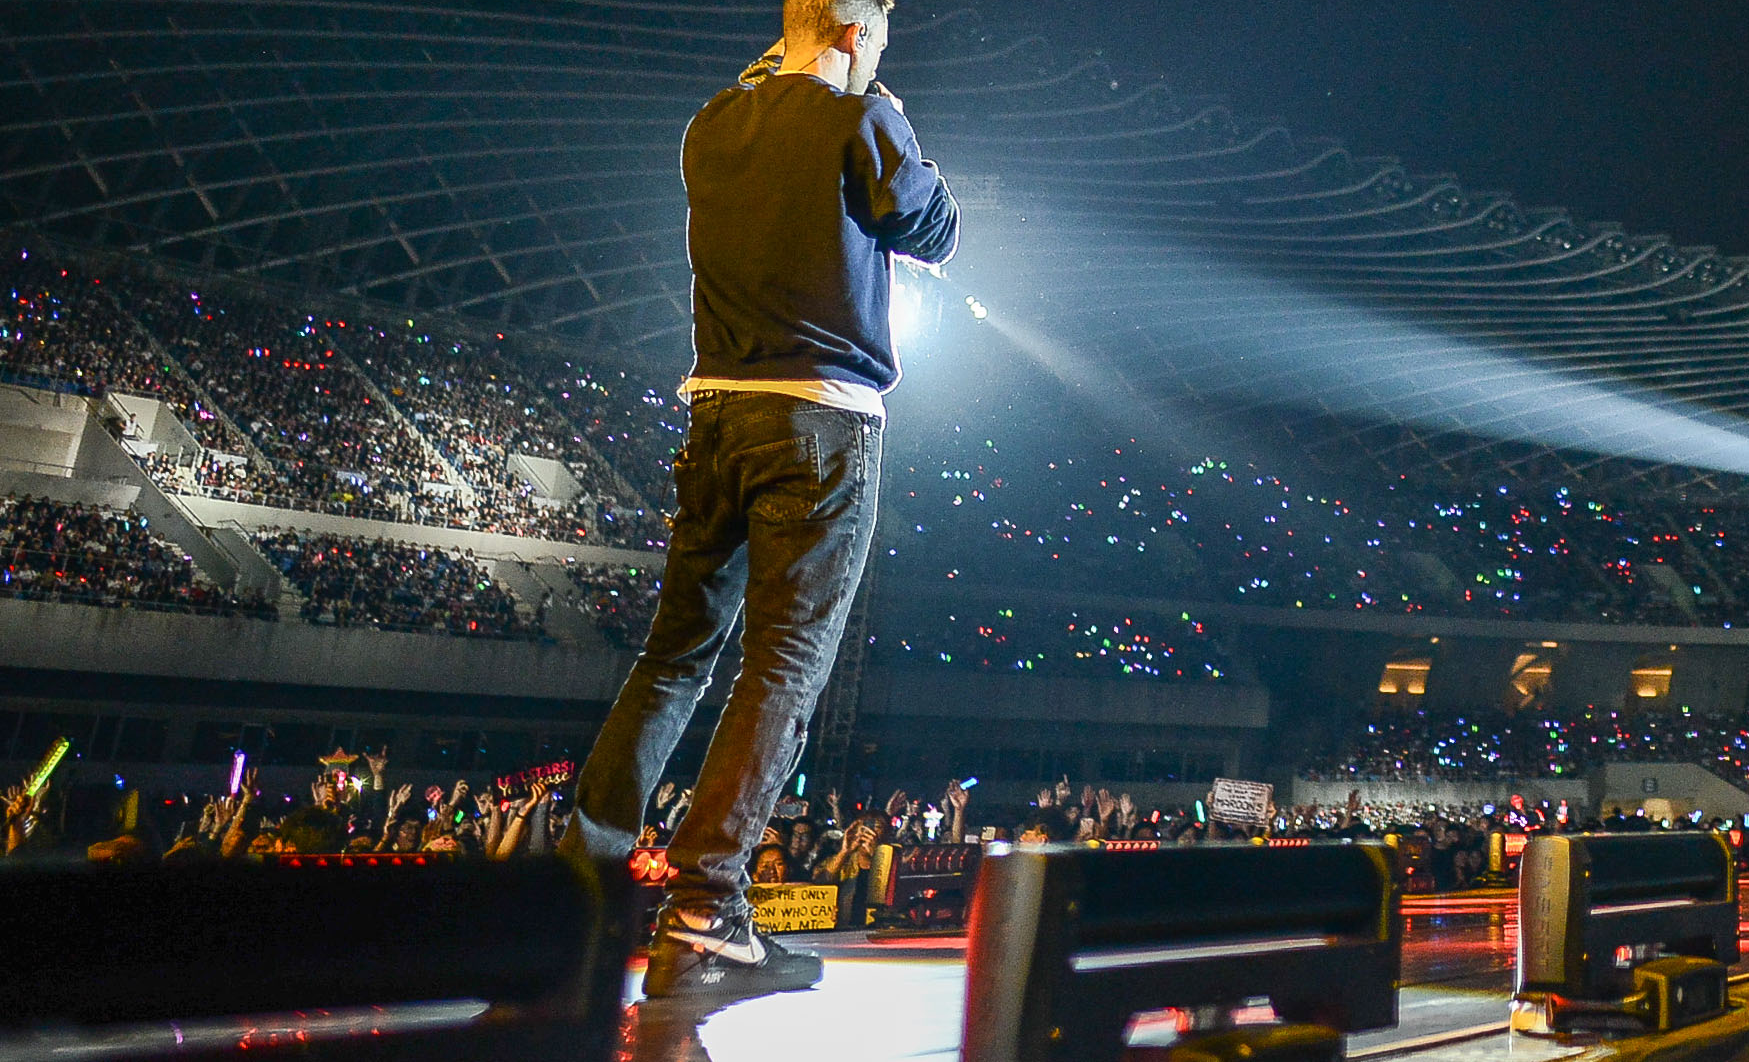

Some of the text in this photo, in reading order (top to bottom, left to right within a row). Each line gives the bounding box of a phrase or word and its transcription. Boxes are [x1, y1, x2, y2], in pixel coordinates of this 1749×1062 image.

[776, 889, 796, 900] THE
[801, 889, 828, 900] ONLY
[752, 905, 776, 919] SON
[781, 906, 808, 918] WHO
[784, 921, 793, 931] A
